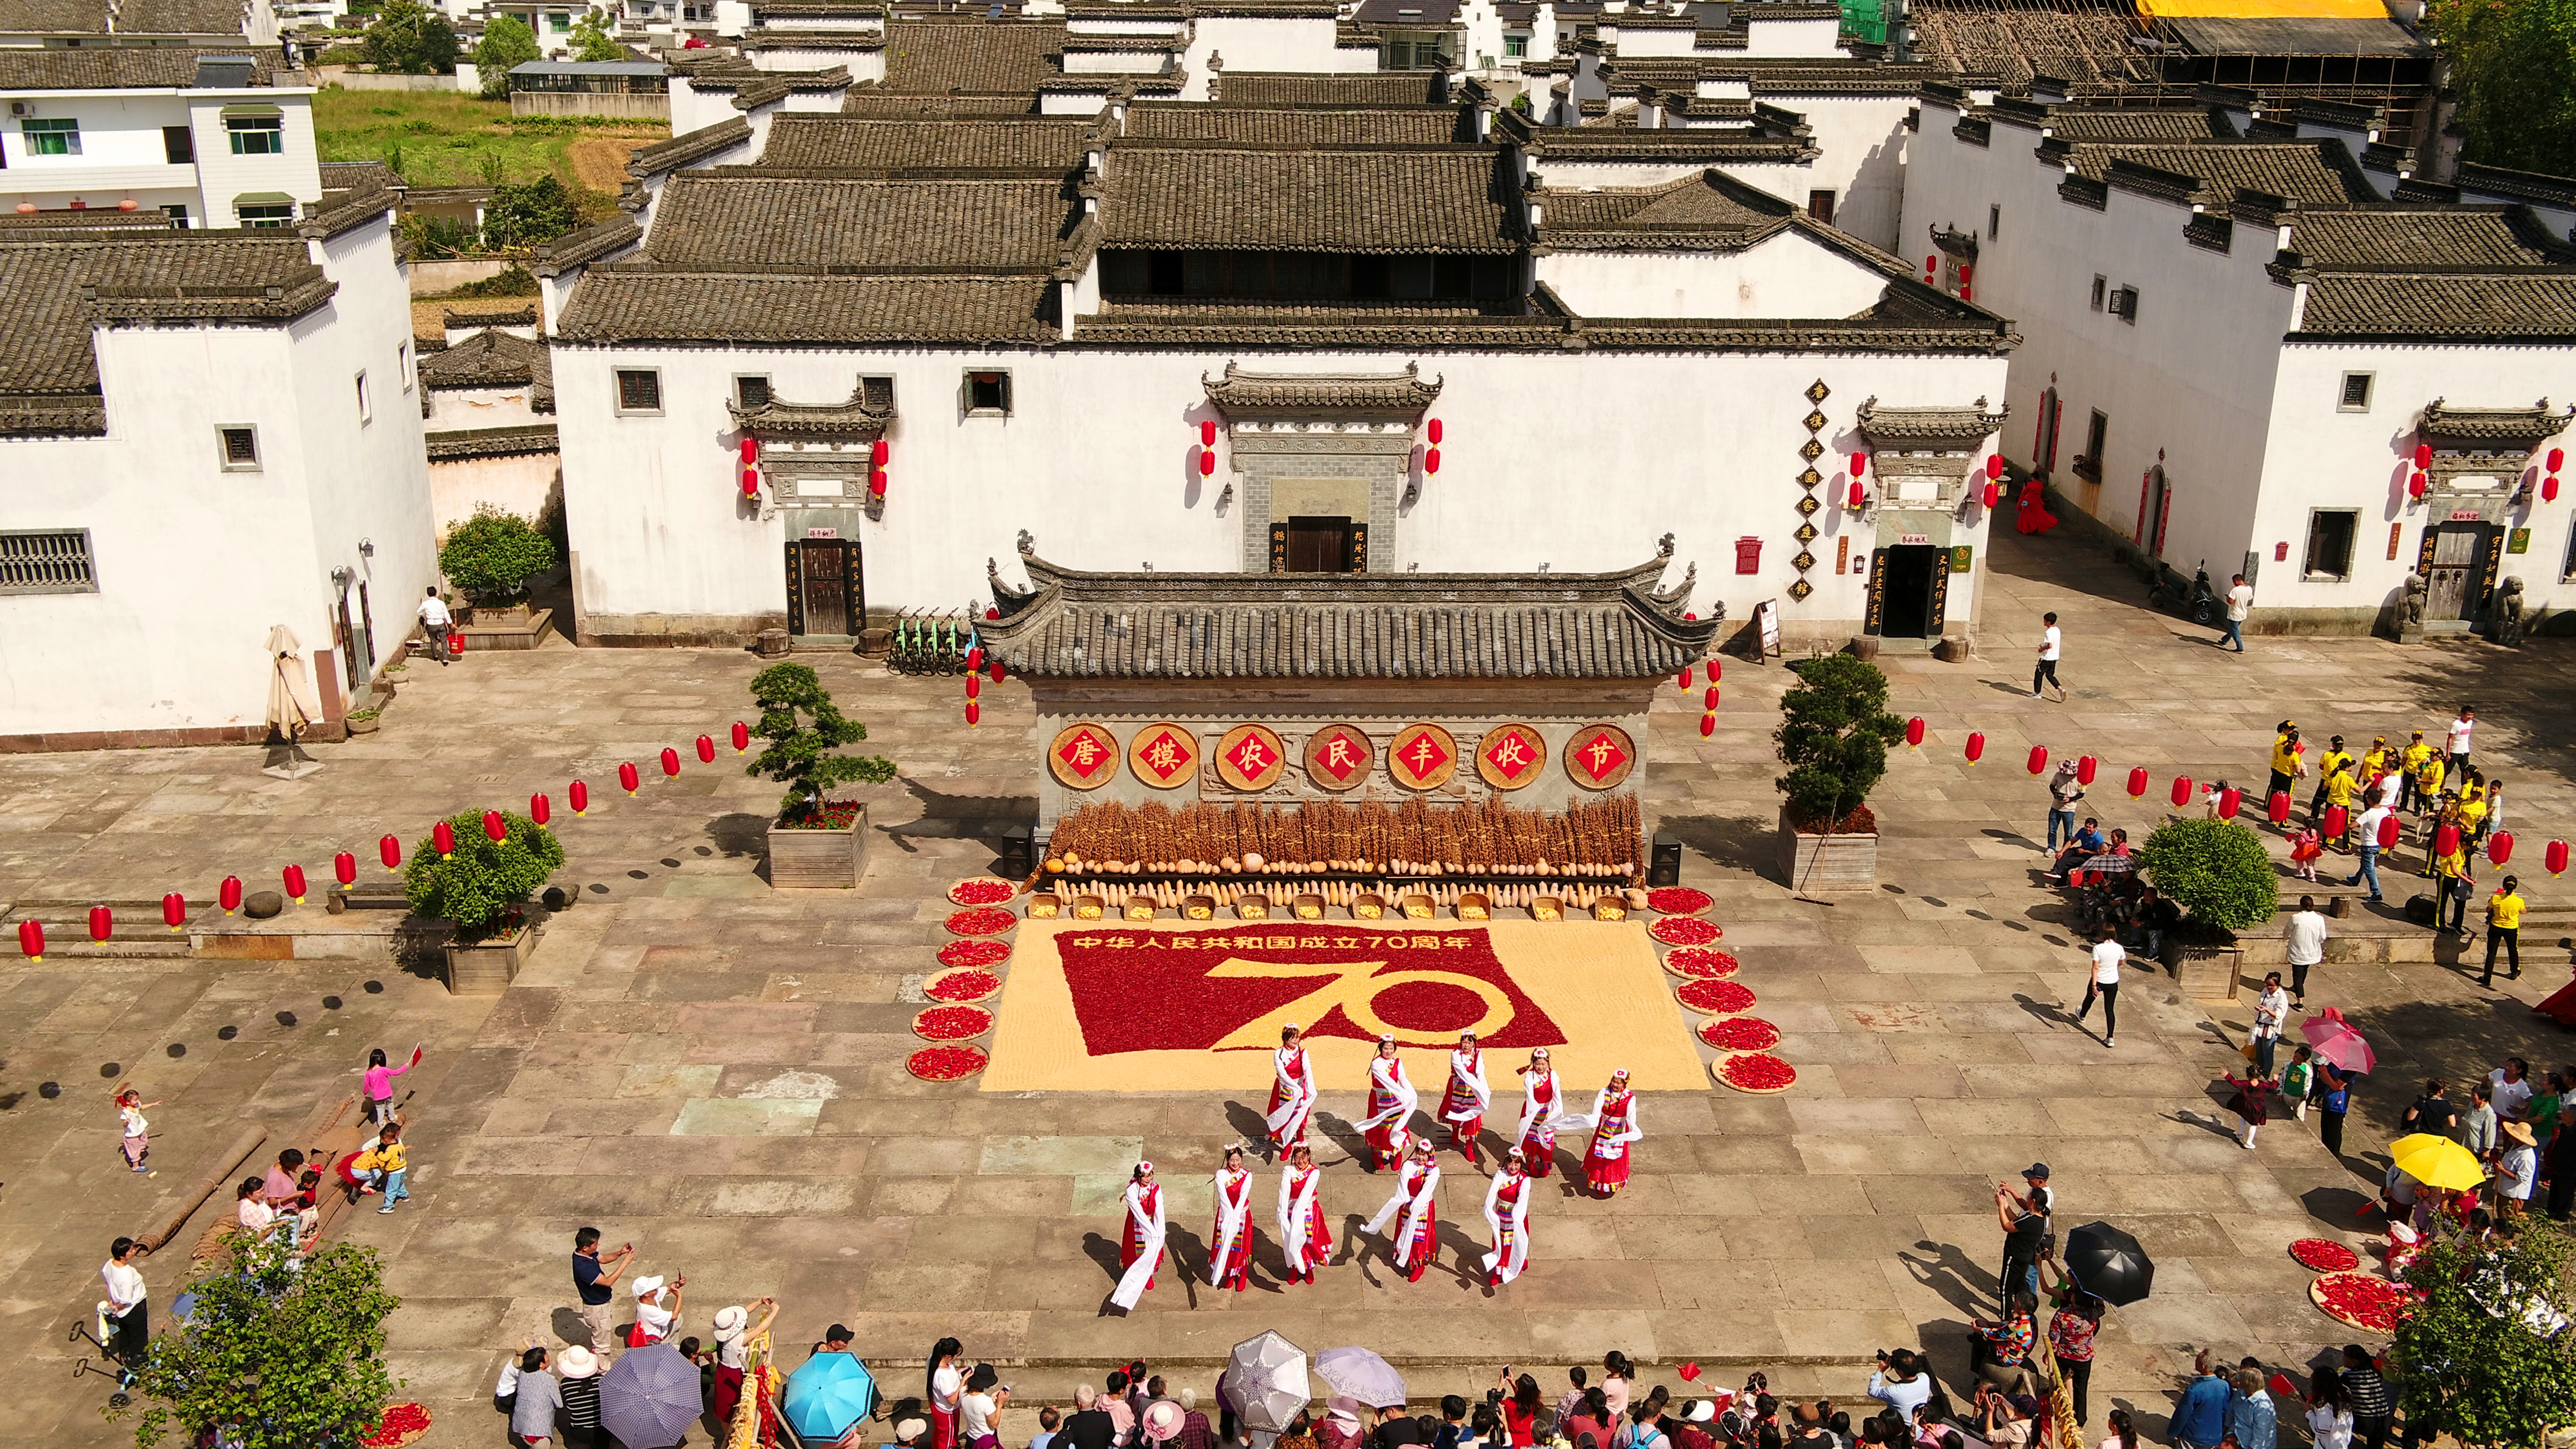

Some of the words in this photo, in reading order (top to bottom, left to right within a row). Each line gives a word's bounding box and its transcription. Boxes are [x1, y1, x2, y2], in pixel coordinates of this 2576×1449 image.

[1069, 735, 1614, 773] 唐模农民丰收节
[1073, 936, 1471, 949] 中华人民共和国成立70周年
[1205, 957, 1515, 1050] 70
